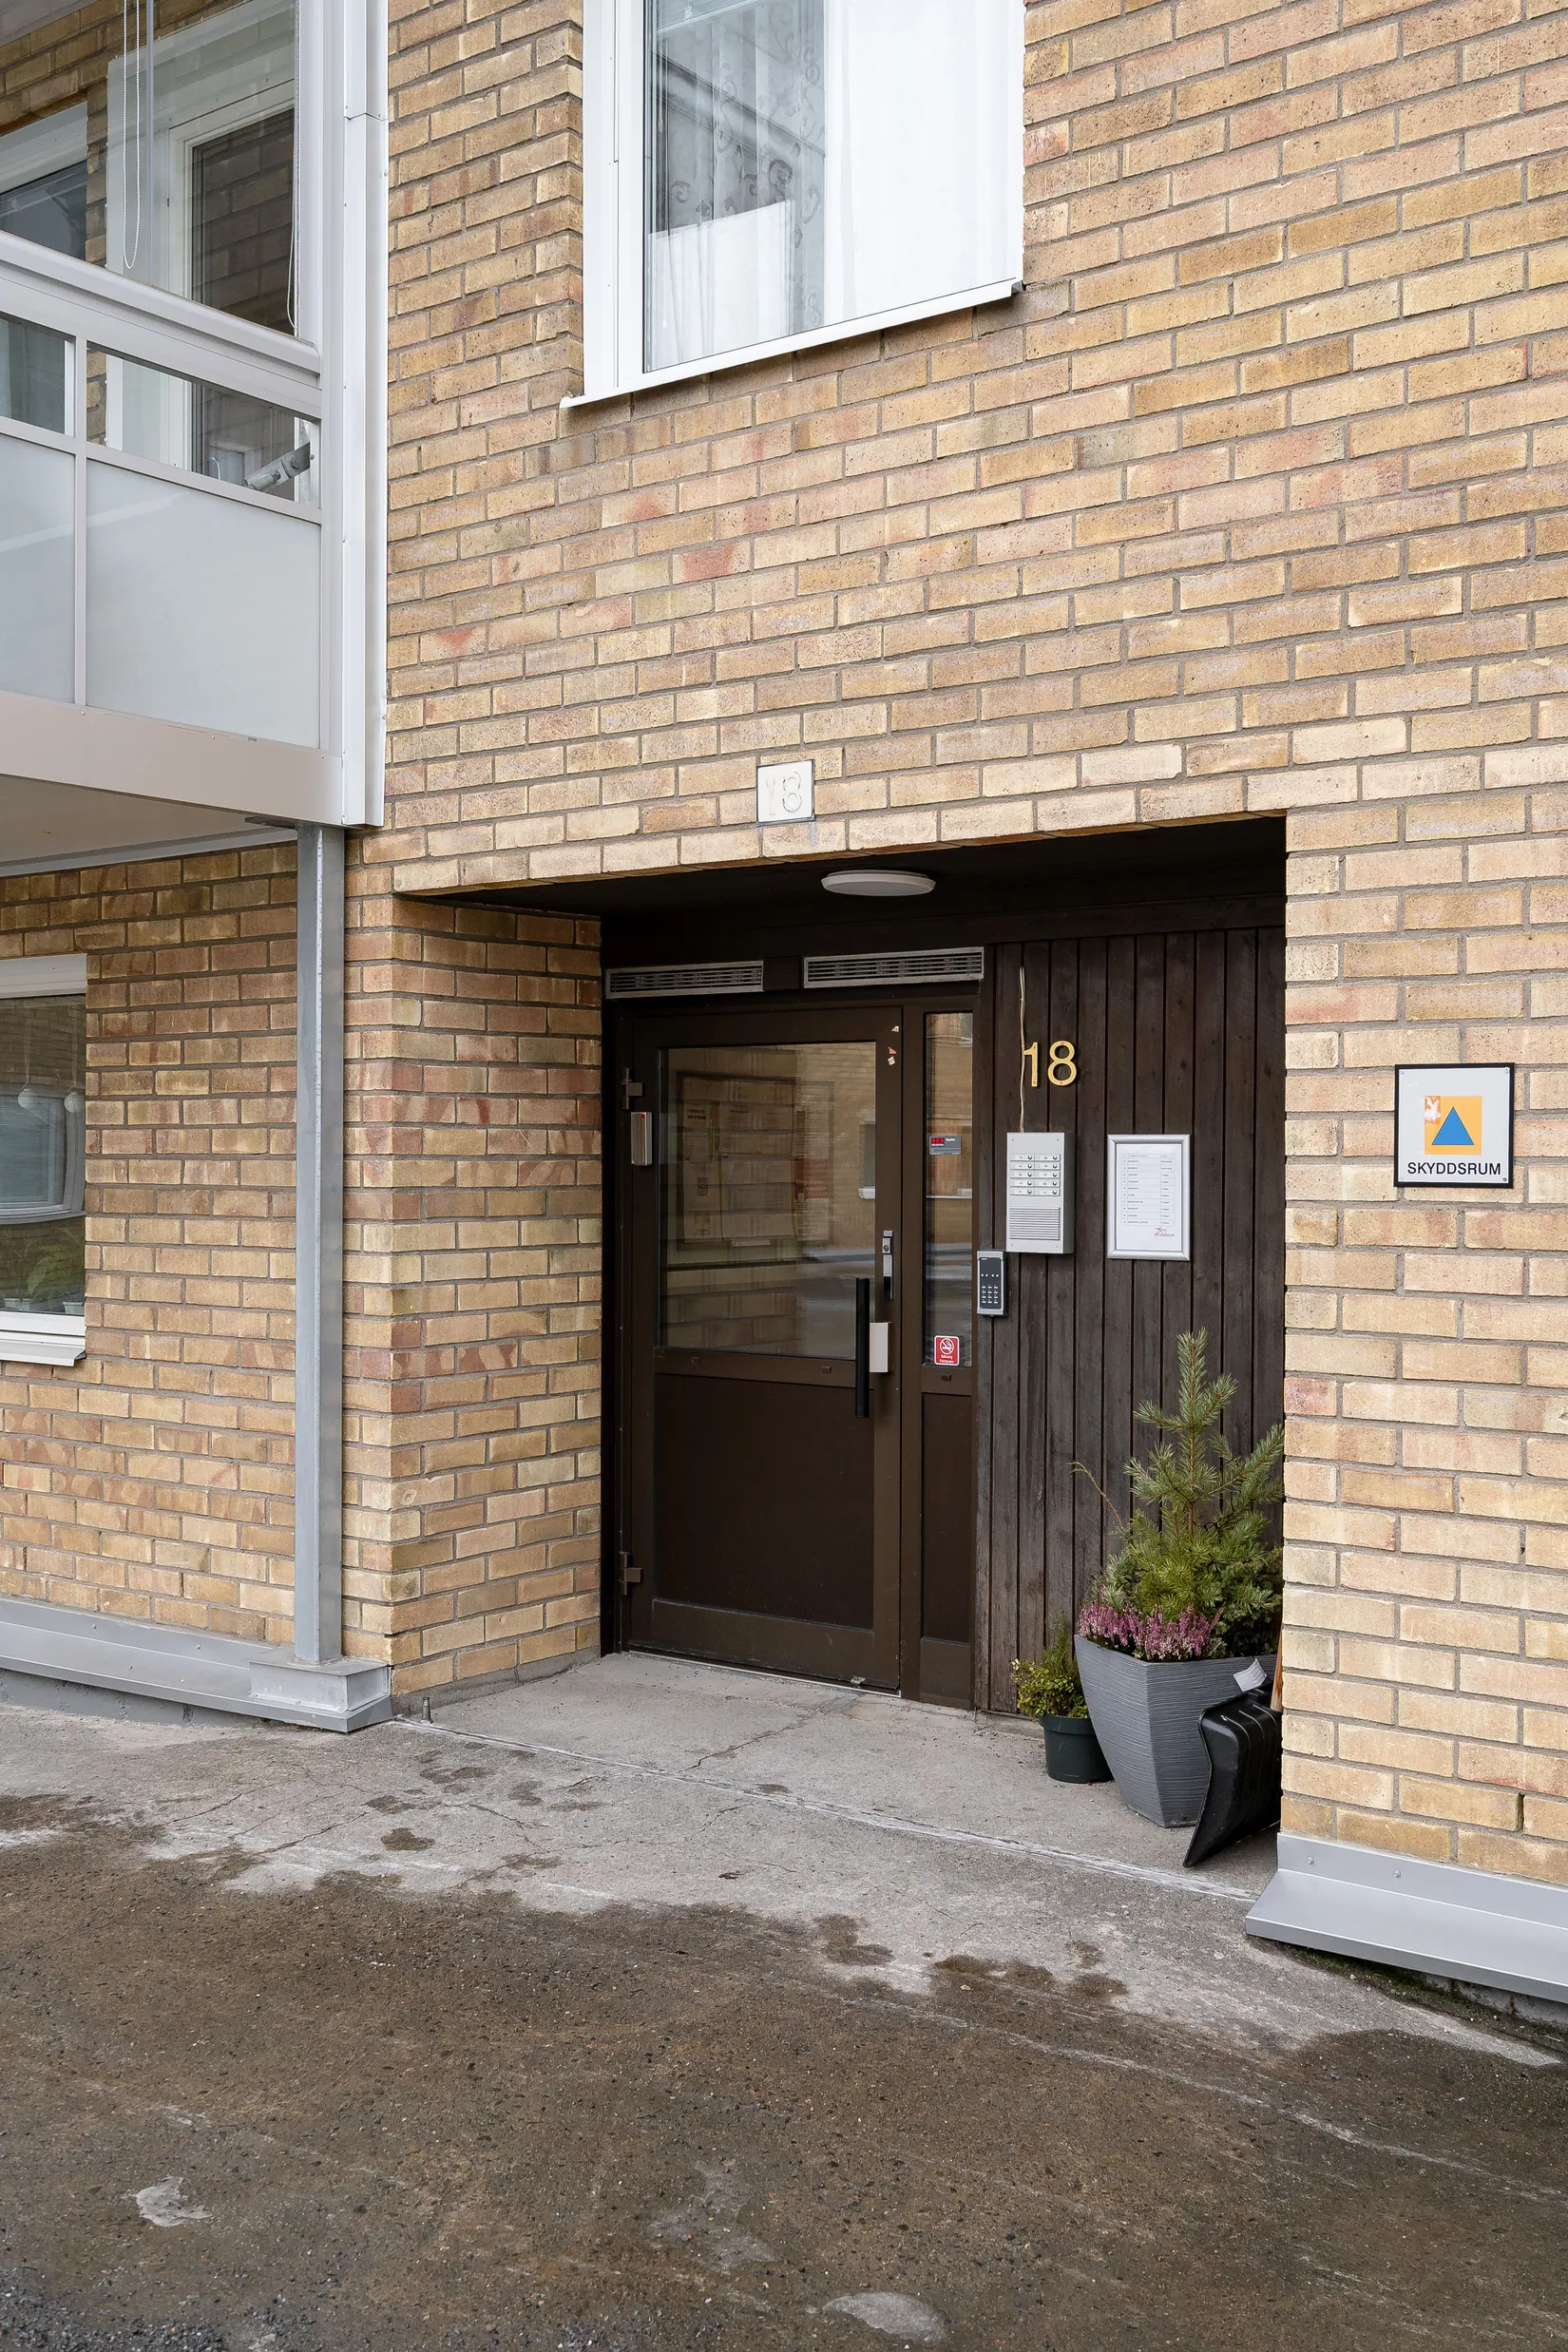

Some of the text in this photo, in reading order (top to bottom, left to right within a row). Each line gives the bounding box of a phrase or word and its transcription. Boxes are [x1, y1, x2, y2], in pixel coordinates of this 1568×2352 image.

[765, 771, 803, 815] 18
[1023, 1041, 1077, 1087] 18
[1407, 1162, 1501, 1176] SKYDDSRUM
